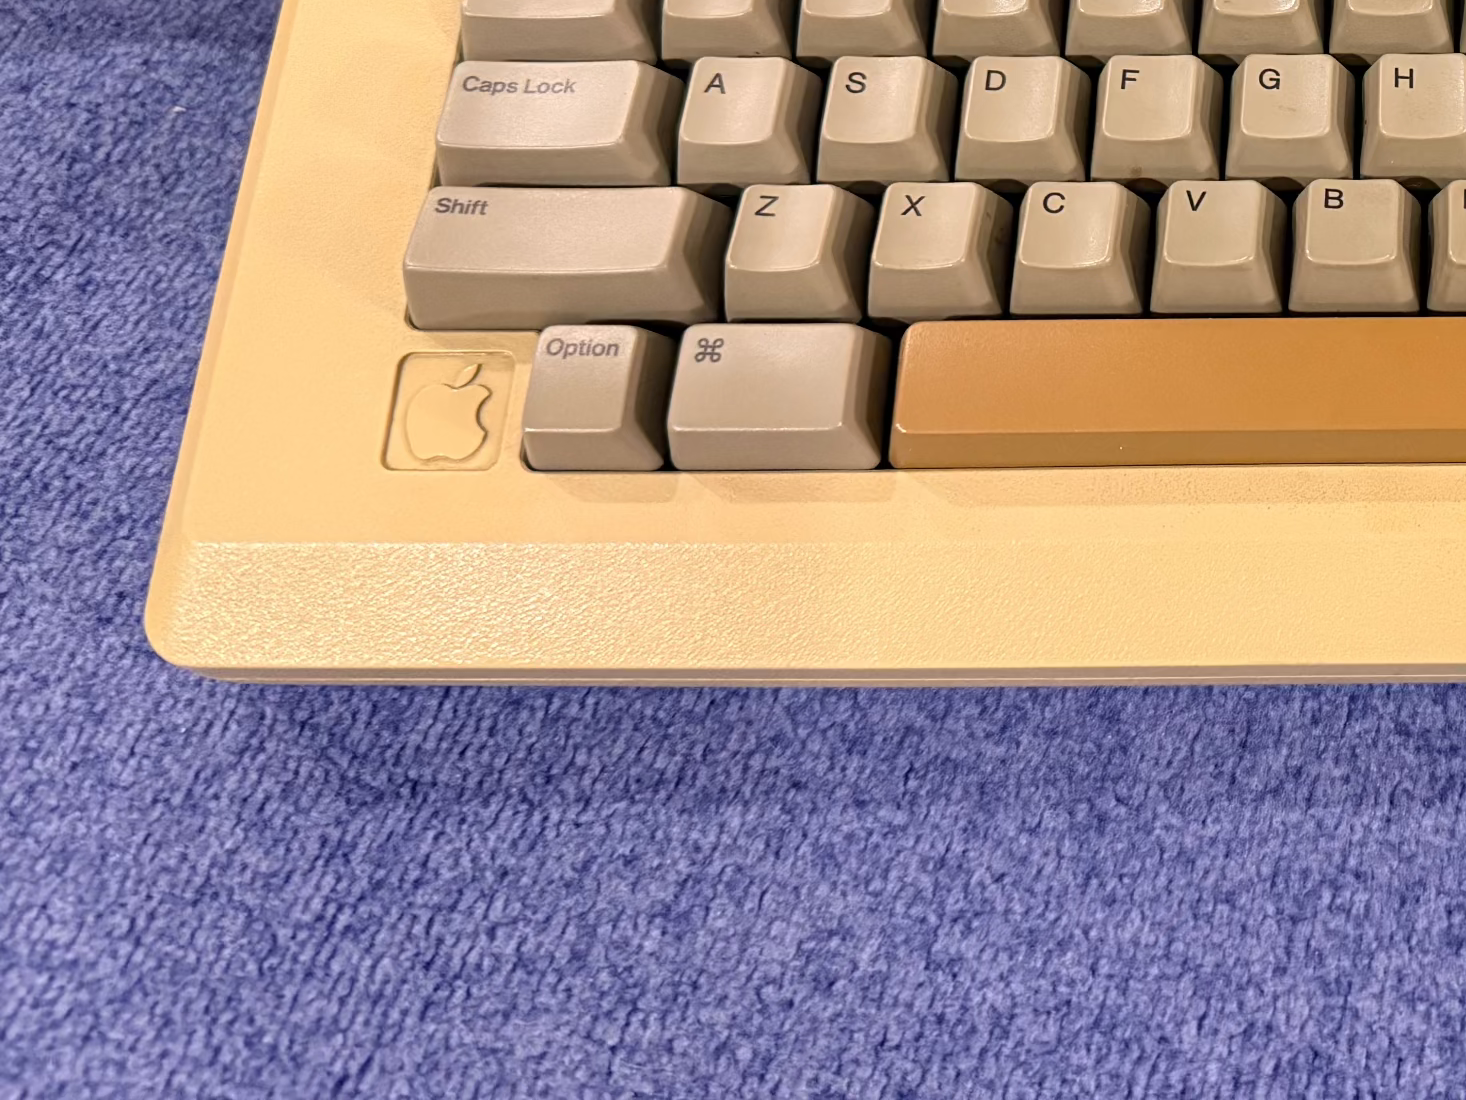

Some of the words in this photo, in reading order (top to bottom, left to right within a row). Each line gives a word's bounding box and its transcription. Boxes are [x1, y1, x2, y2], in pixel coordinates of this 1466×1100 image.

[462, 75, 519, 96] Caps
[522, 78, 577, 94] Lock
[704, 72, 727, 95] A
[845, 71, 867, 94] S
[984, 69, 1007, 91] D
[1120, 68, 1140, 90] F
[1258, 68, 1281, 90] G
[1394, 67, 1414, 89] H
[434, 197, 489, 216] Shift
[754, 195, 780, 217] Z
[900, 194, 926, 217] X
[1042, 192, 1066, 214] C
[1185, 189, 1207, 212] V
[1323, 188, 1344, 210] B
[545, 337, 620, 359] Option
